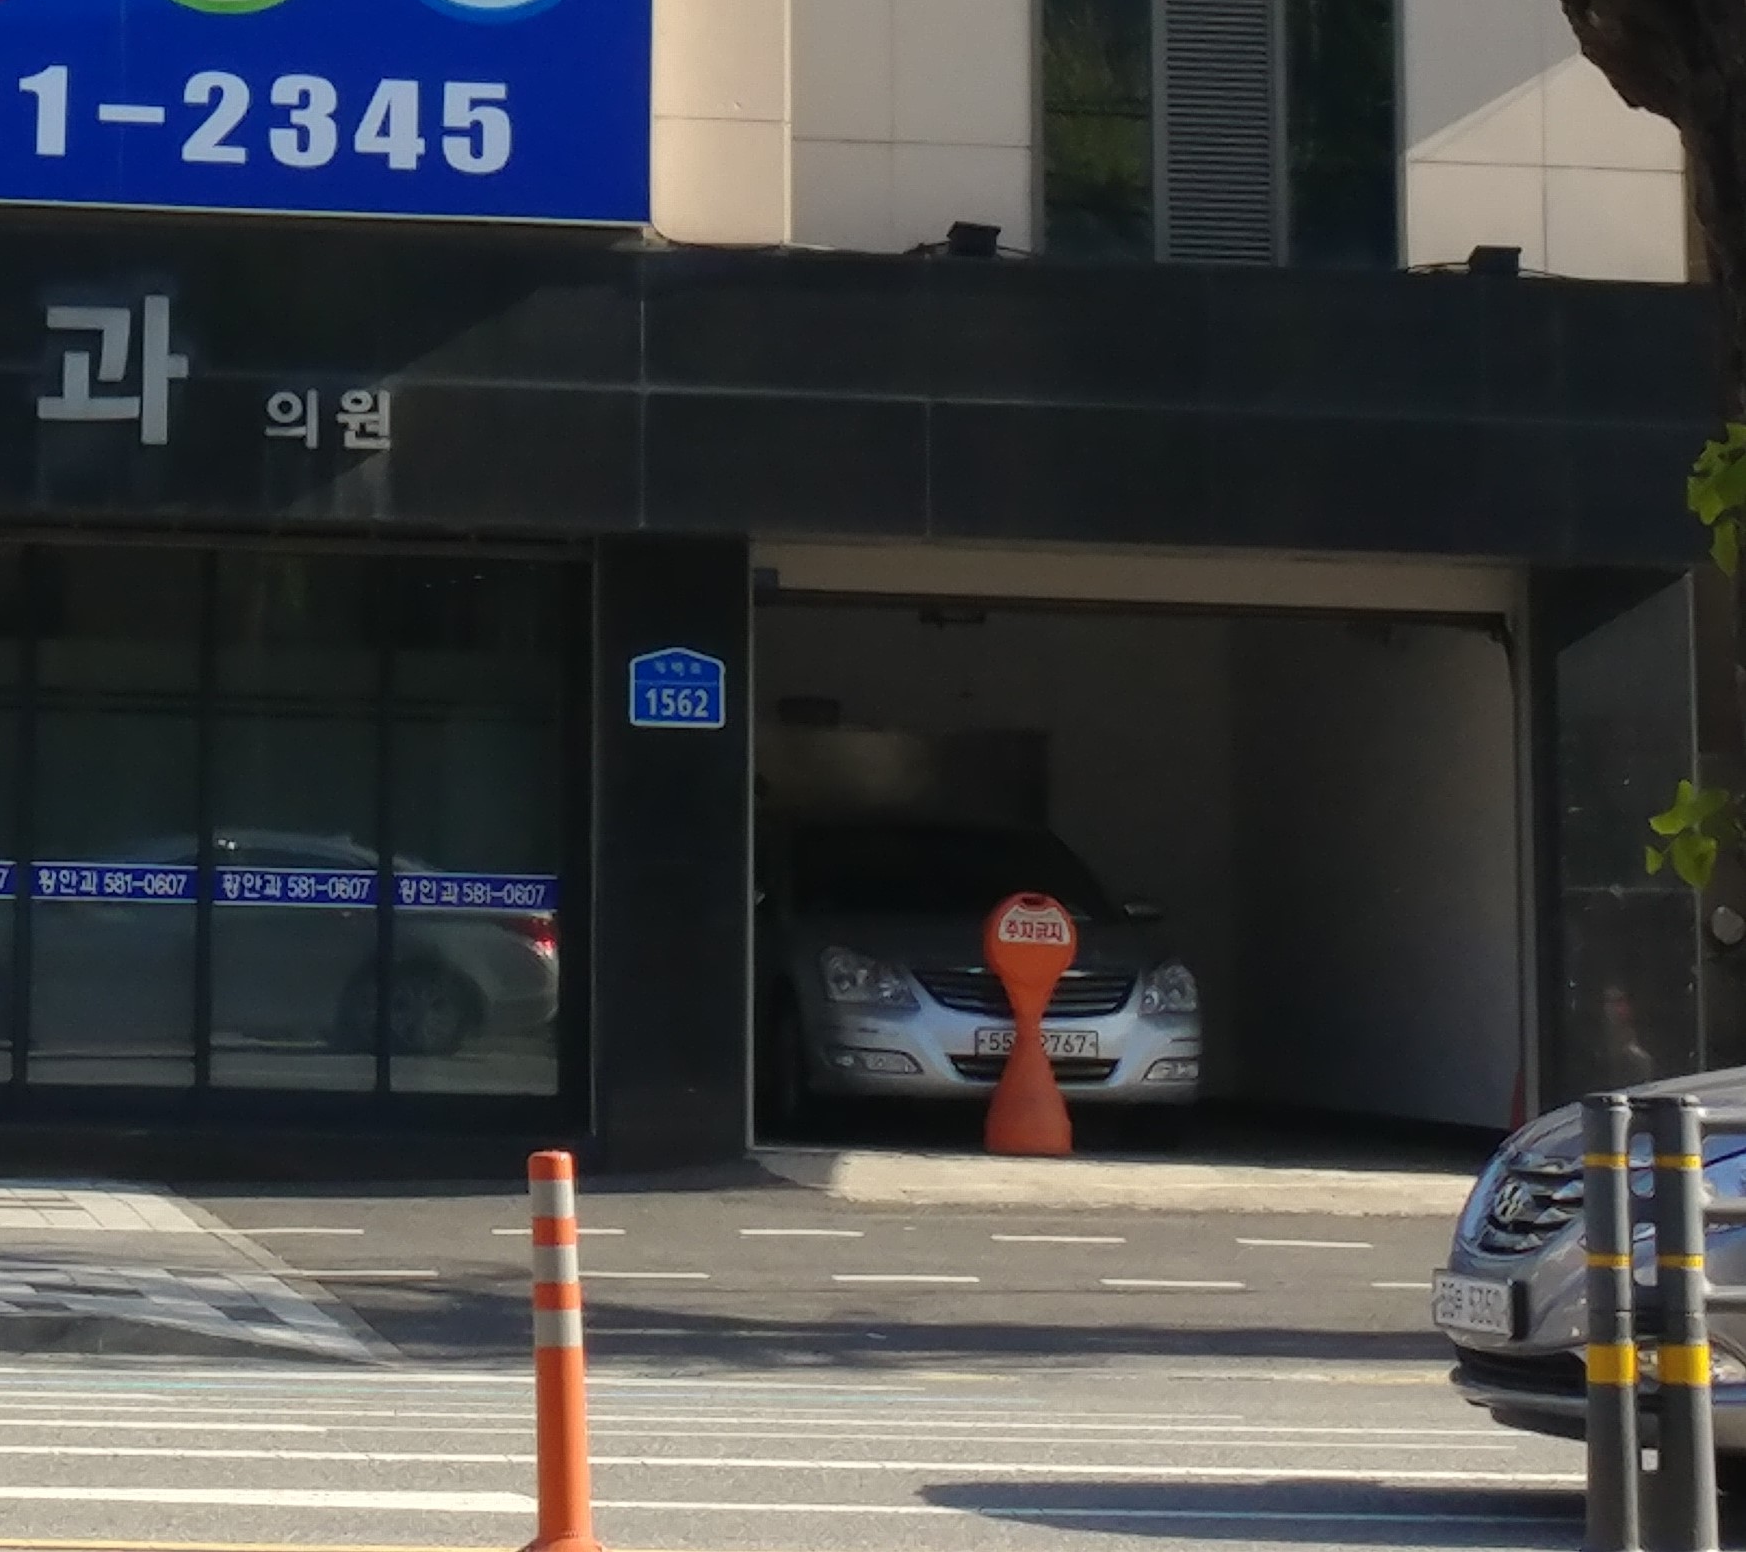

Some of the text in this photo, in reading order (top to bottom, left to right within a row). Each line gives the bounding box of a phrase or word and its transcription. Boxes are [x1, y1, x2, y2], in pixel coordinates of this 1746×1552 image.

[264, 388, 393, 451] 의원
[645, 688, 709, 718] 1562
[38, 869, 188, 896] 황안과 581-0607
[222, 873, 372, 901] 황안과 581-0607
[399, 880, 546, 907] 황안과 581-0607
